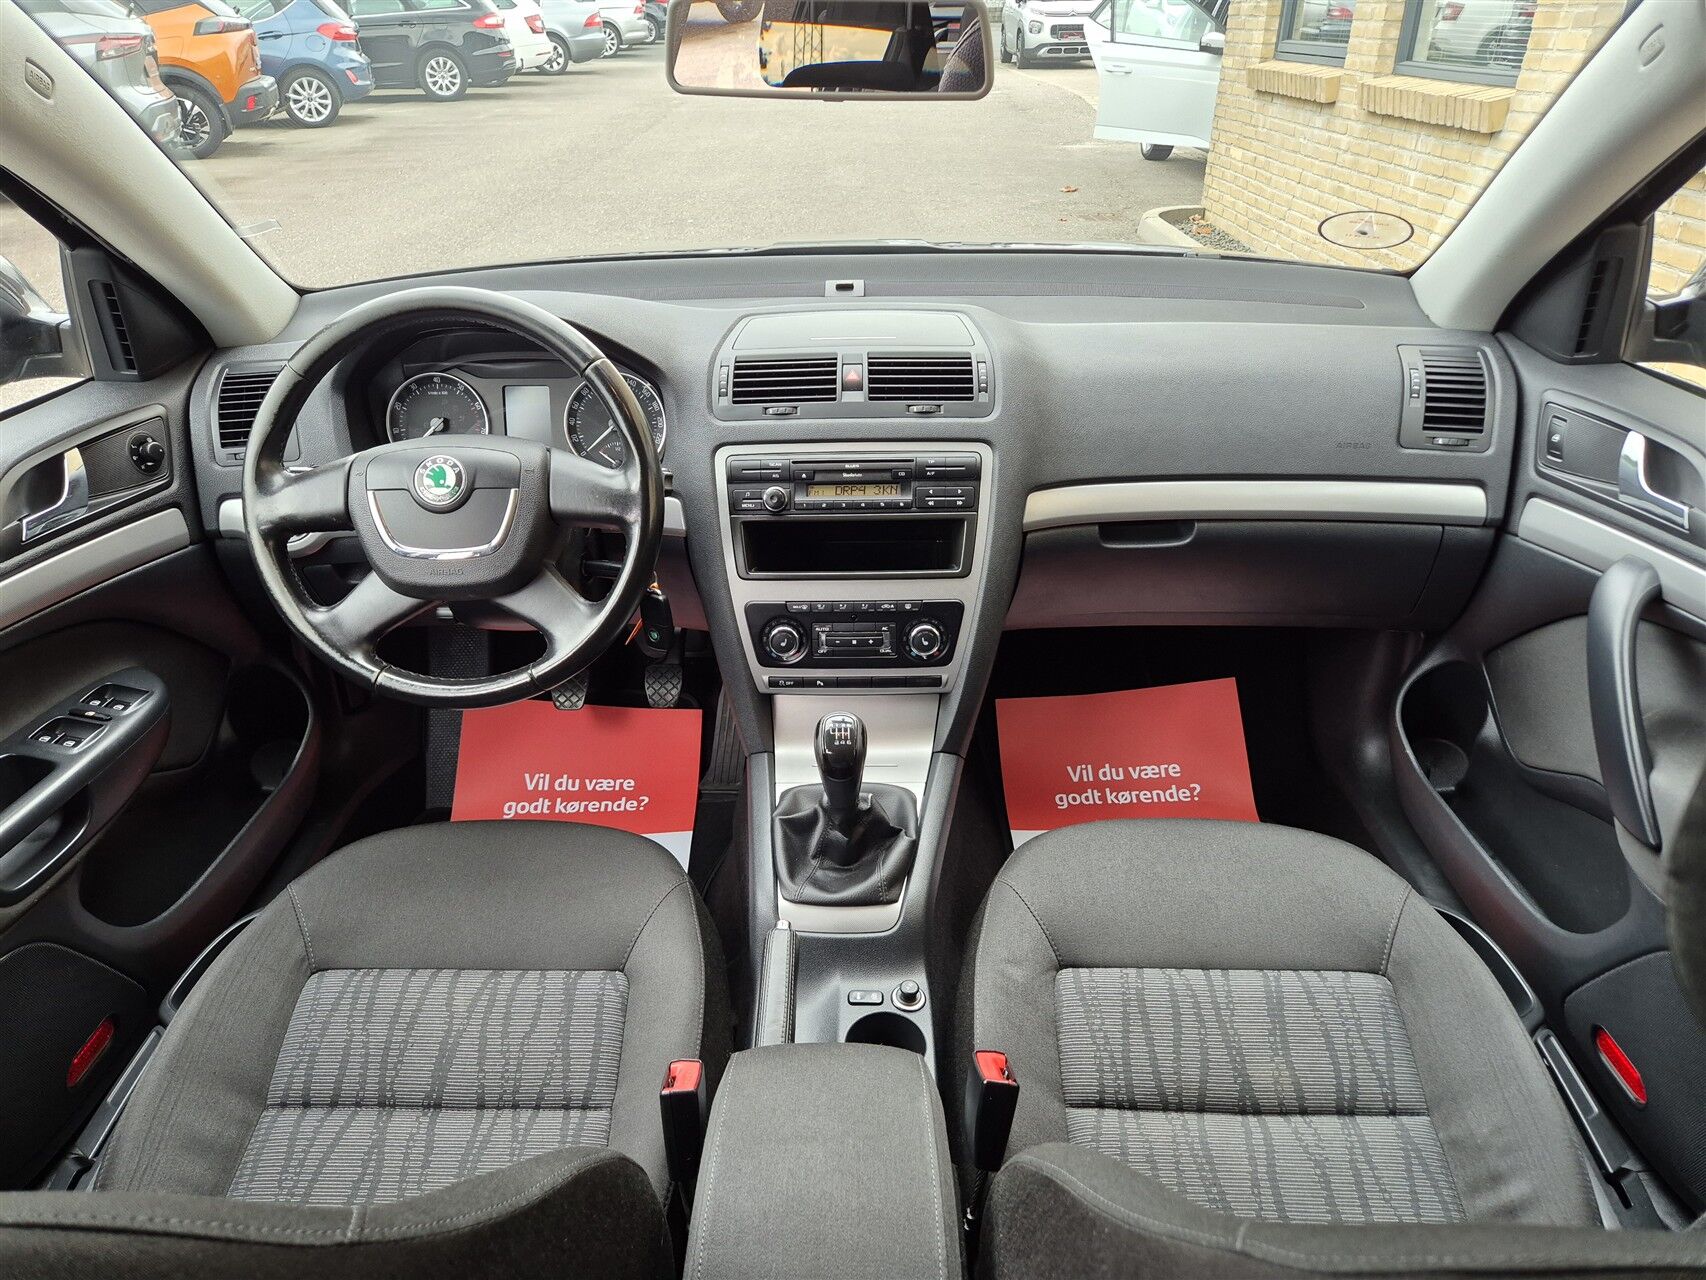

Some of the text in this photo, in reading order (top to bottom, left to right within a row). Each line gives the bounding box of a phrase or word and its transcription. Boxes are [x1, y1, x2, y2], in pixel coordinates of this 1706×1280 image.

[1336, 441, 1371, 449] AIRBAG
[524, 773, 635, 791] Vil du være
[1067, 762, 1182, 782] Vil du være
[1054, 783, 1201, 809] godt kørende?
[503, 796, 649, 819] godt kørende?
